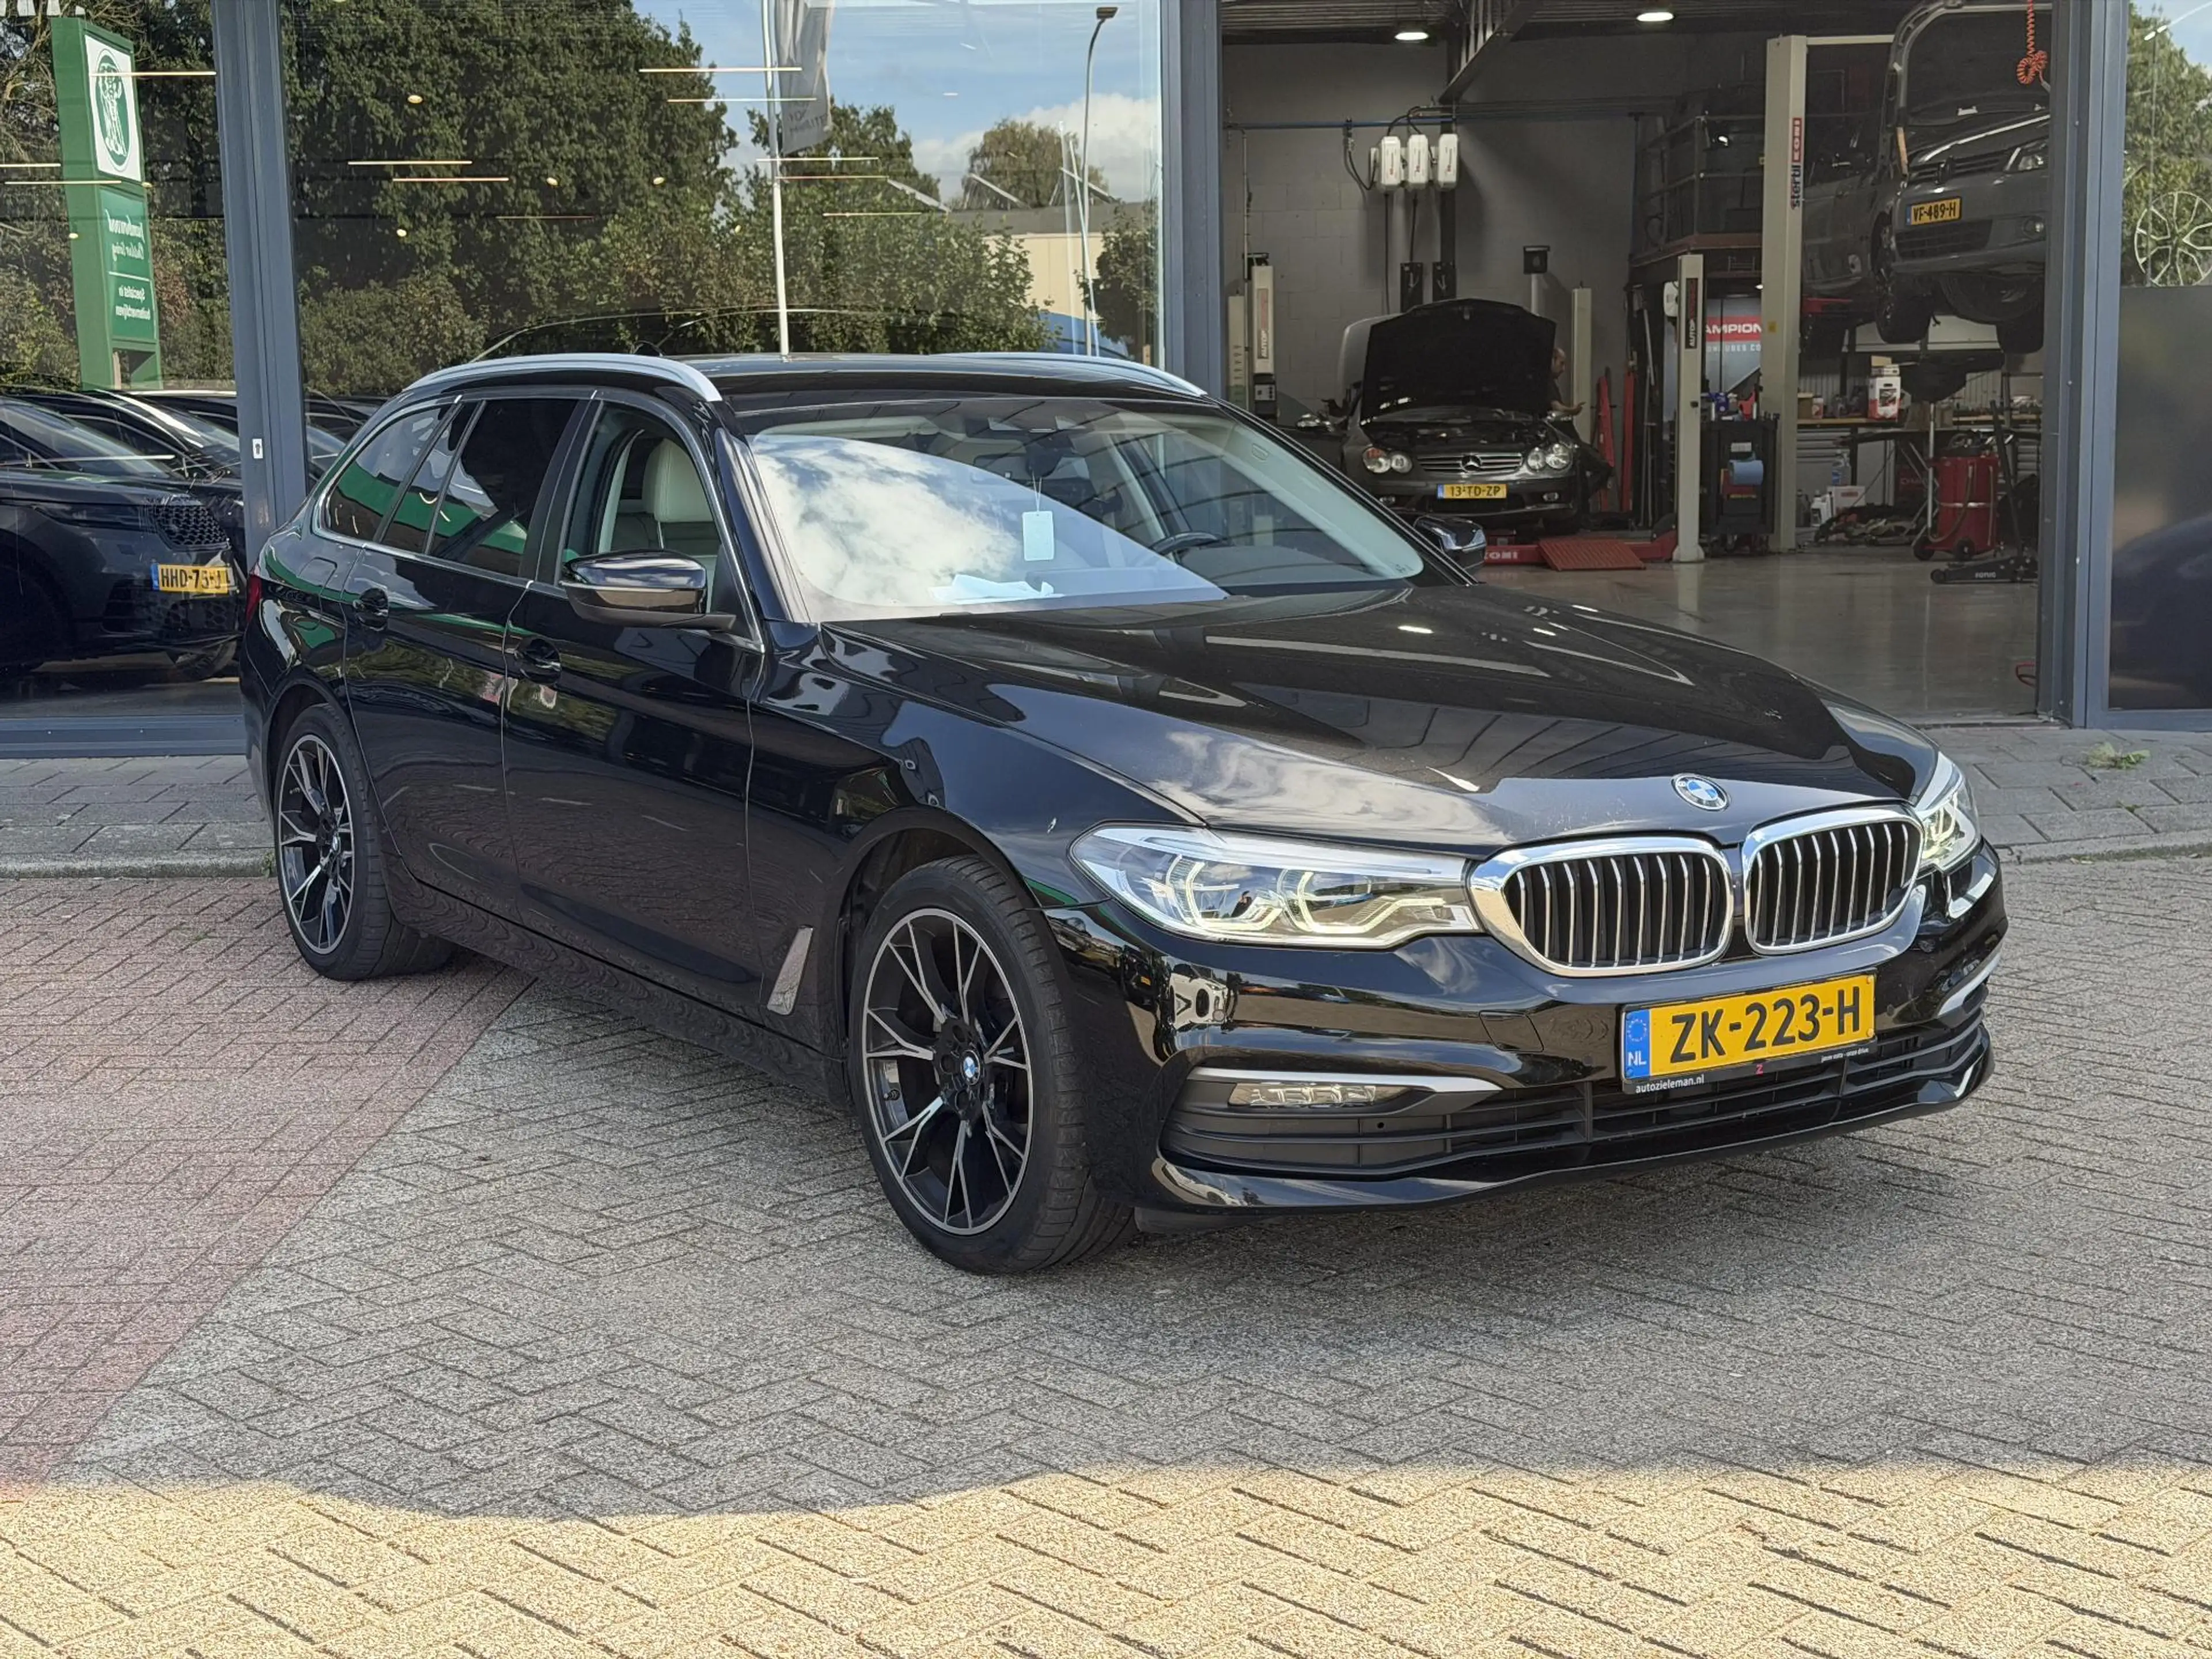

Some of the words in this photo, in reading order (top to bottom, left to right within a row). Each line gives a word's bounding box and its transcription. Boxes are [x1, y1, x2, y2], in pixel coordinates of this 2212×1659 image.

[1913, 202, 1956, 222] VF-489-H
[1628, 1051, 1646, 1066] NL
[1670, 986, 1860, 1063] ZK-223-H
[1636, 1074, 1705, 1094] autozieleman.nl
